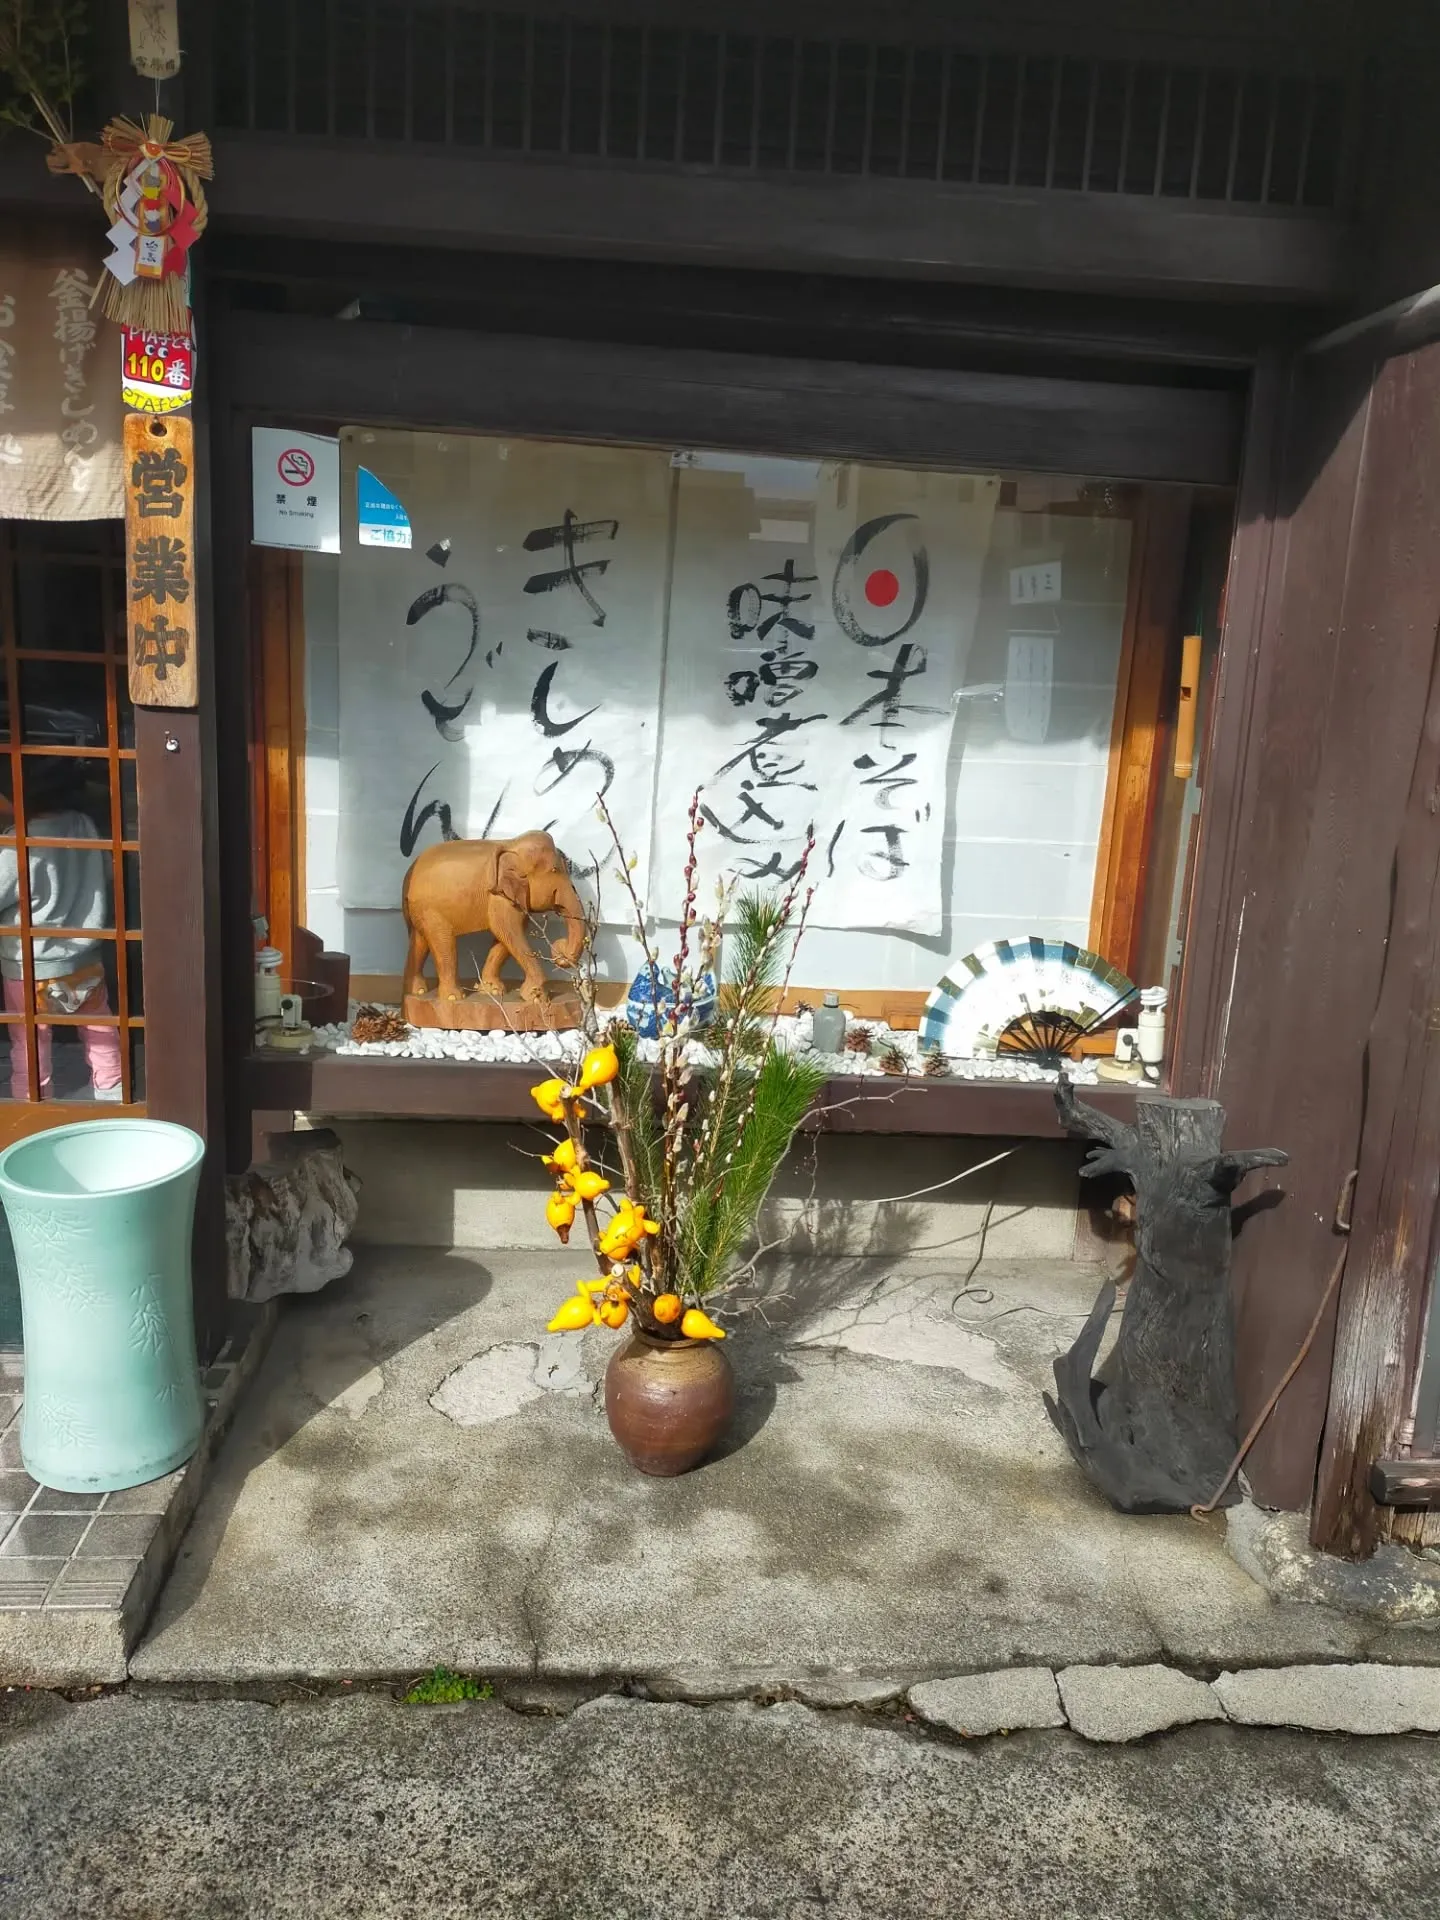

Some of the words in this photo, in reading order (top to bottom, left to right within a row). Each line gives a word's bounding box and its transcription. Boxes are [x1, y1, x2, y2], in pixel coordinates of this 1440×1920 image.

[127, 352, 190, 386] 110番
[279, 509, 288, 517] No
[288, 509, 315, 519] Smoking
[131, 447, 190, 681] 営業中
